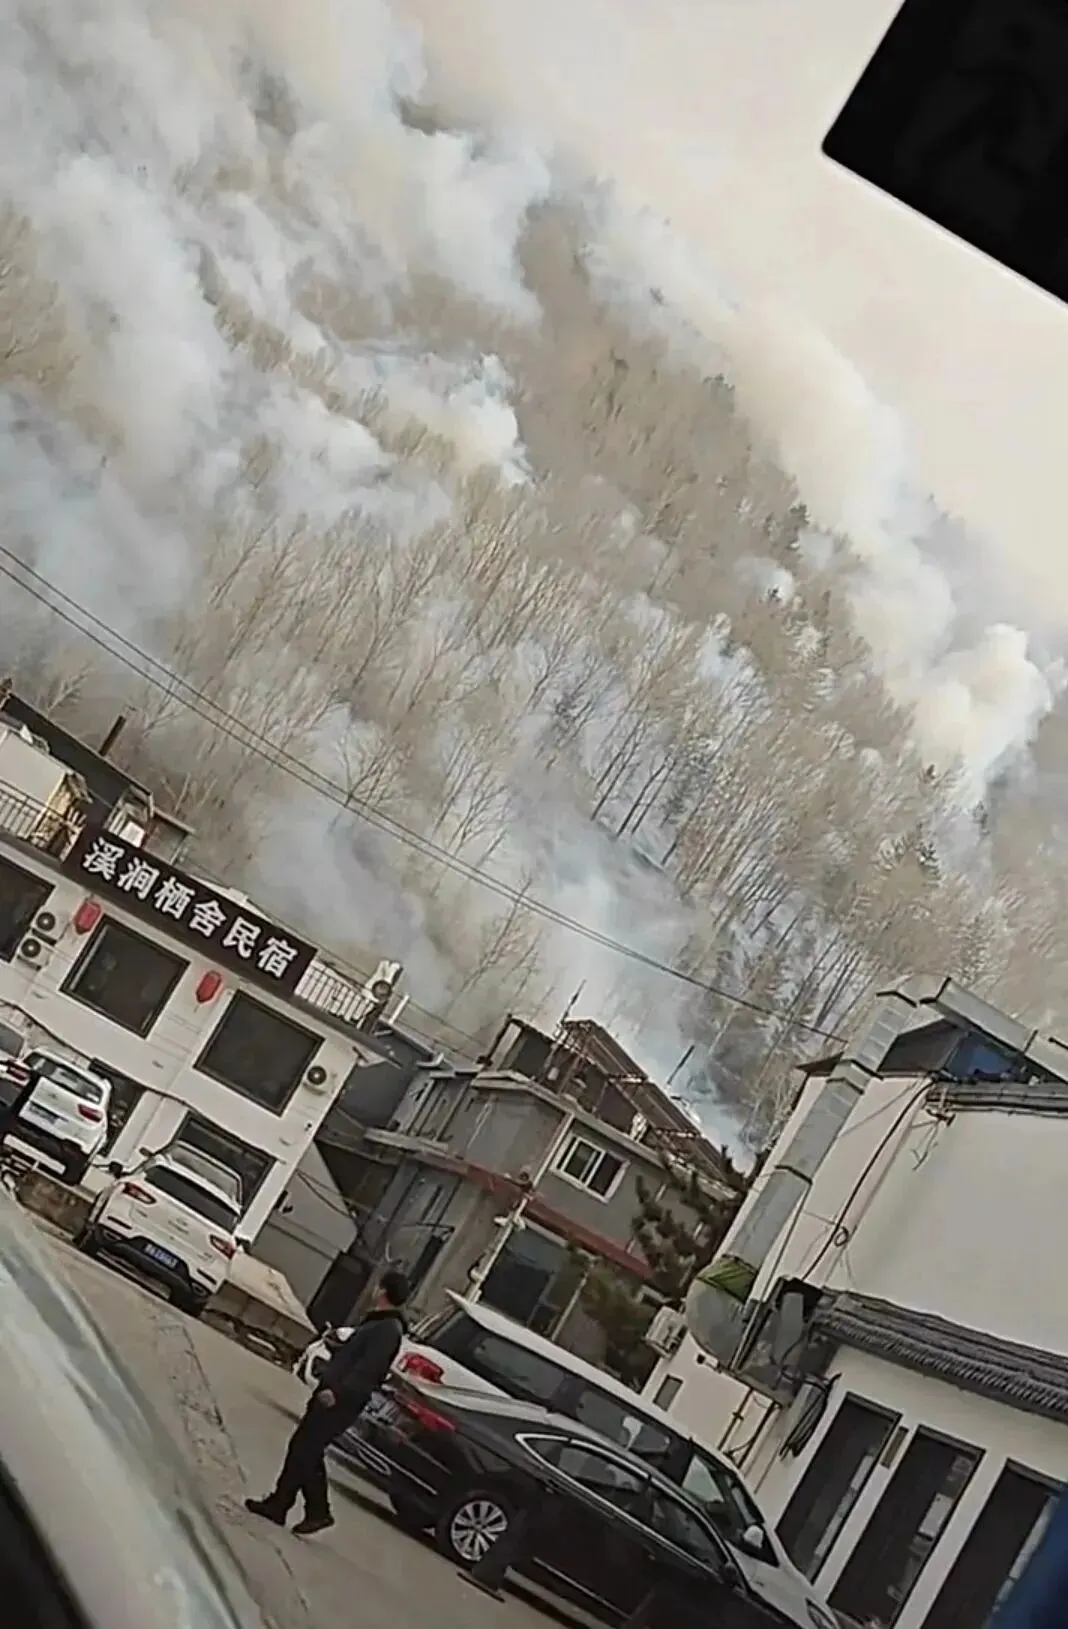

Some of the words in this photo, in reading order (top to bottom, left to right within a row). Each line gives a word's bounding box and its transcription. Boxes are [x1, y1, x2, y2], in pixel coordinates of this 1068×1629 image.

[82, 837, 298, 979] 溪涧栖舍民宿
